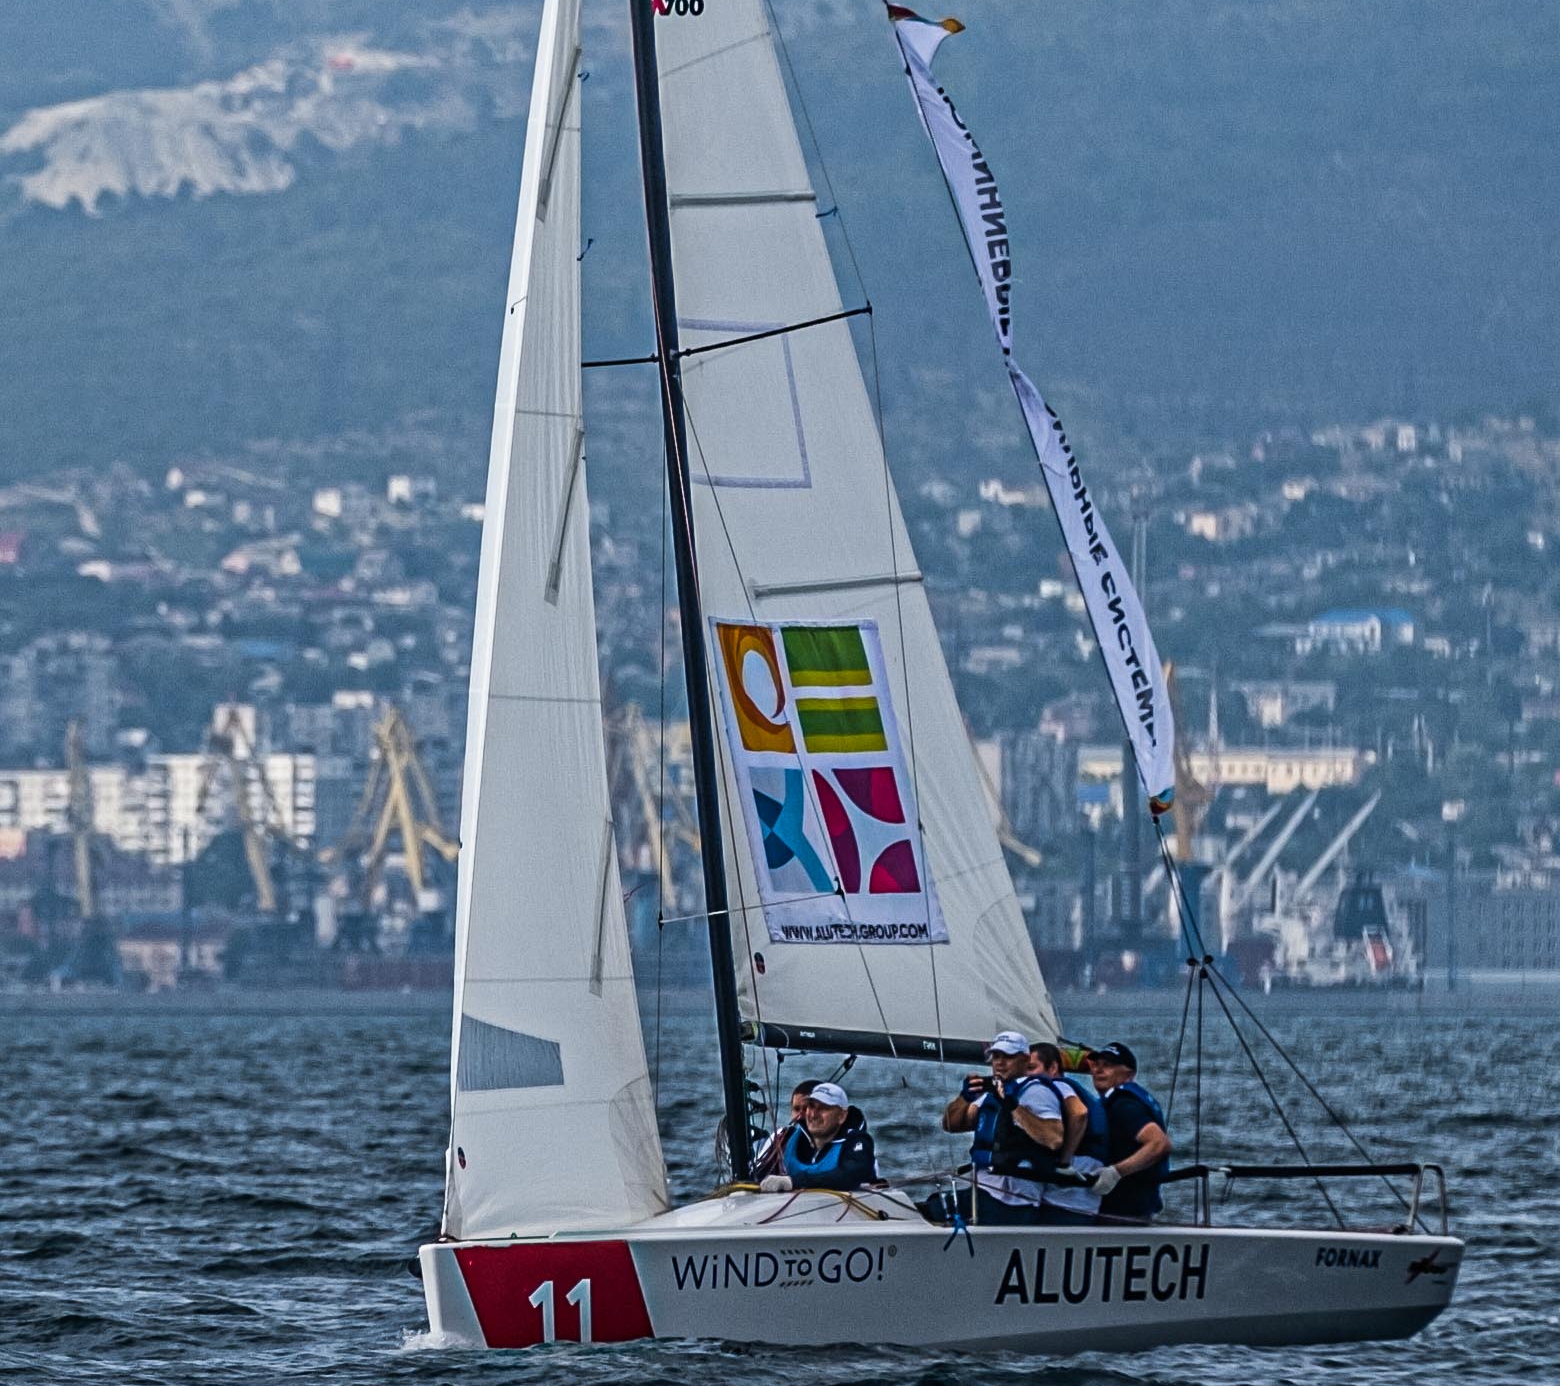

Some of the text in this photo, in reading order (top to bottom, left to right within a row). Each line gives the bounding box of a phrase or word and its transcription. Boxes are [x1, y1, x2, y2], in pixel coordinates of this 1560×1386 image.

[994, 1243, 1210, 1304] ALUTECH
[1315, 1247, 1382, 1269] FORNAX
[528, 1278, 592, 1343] 11
